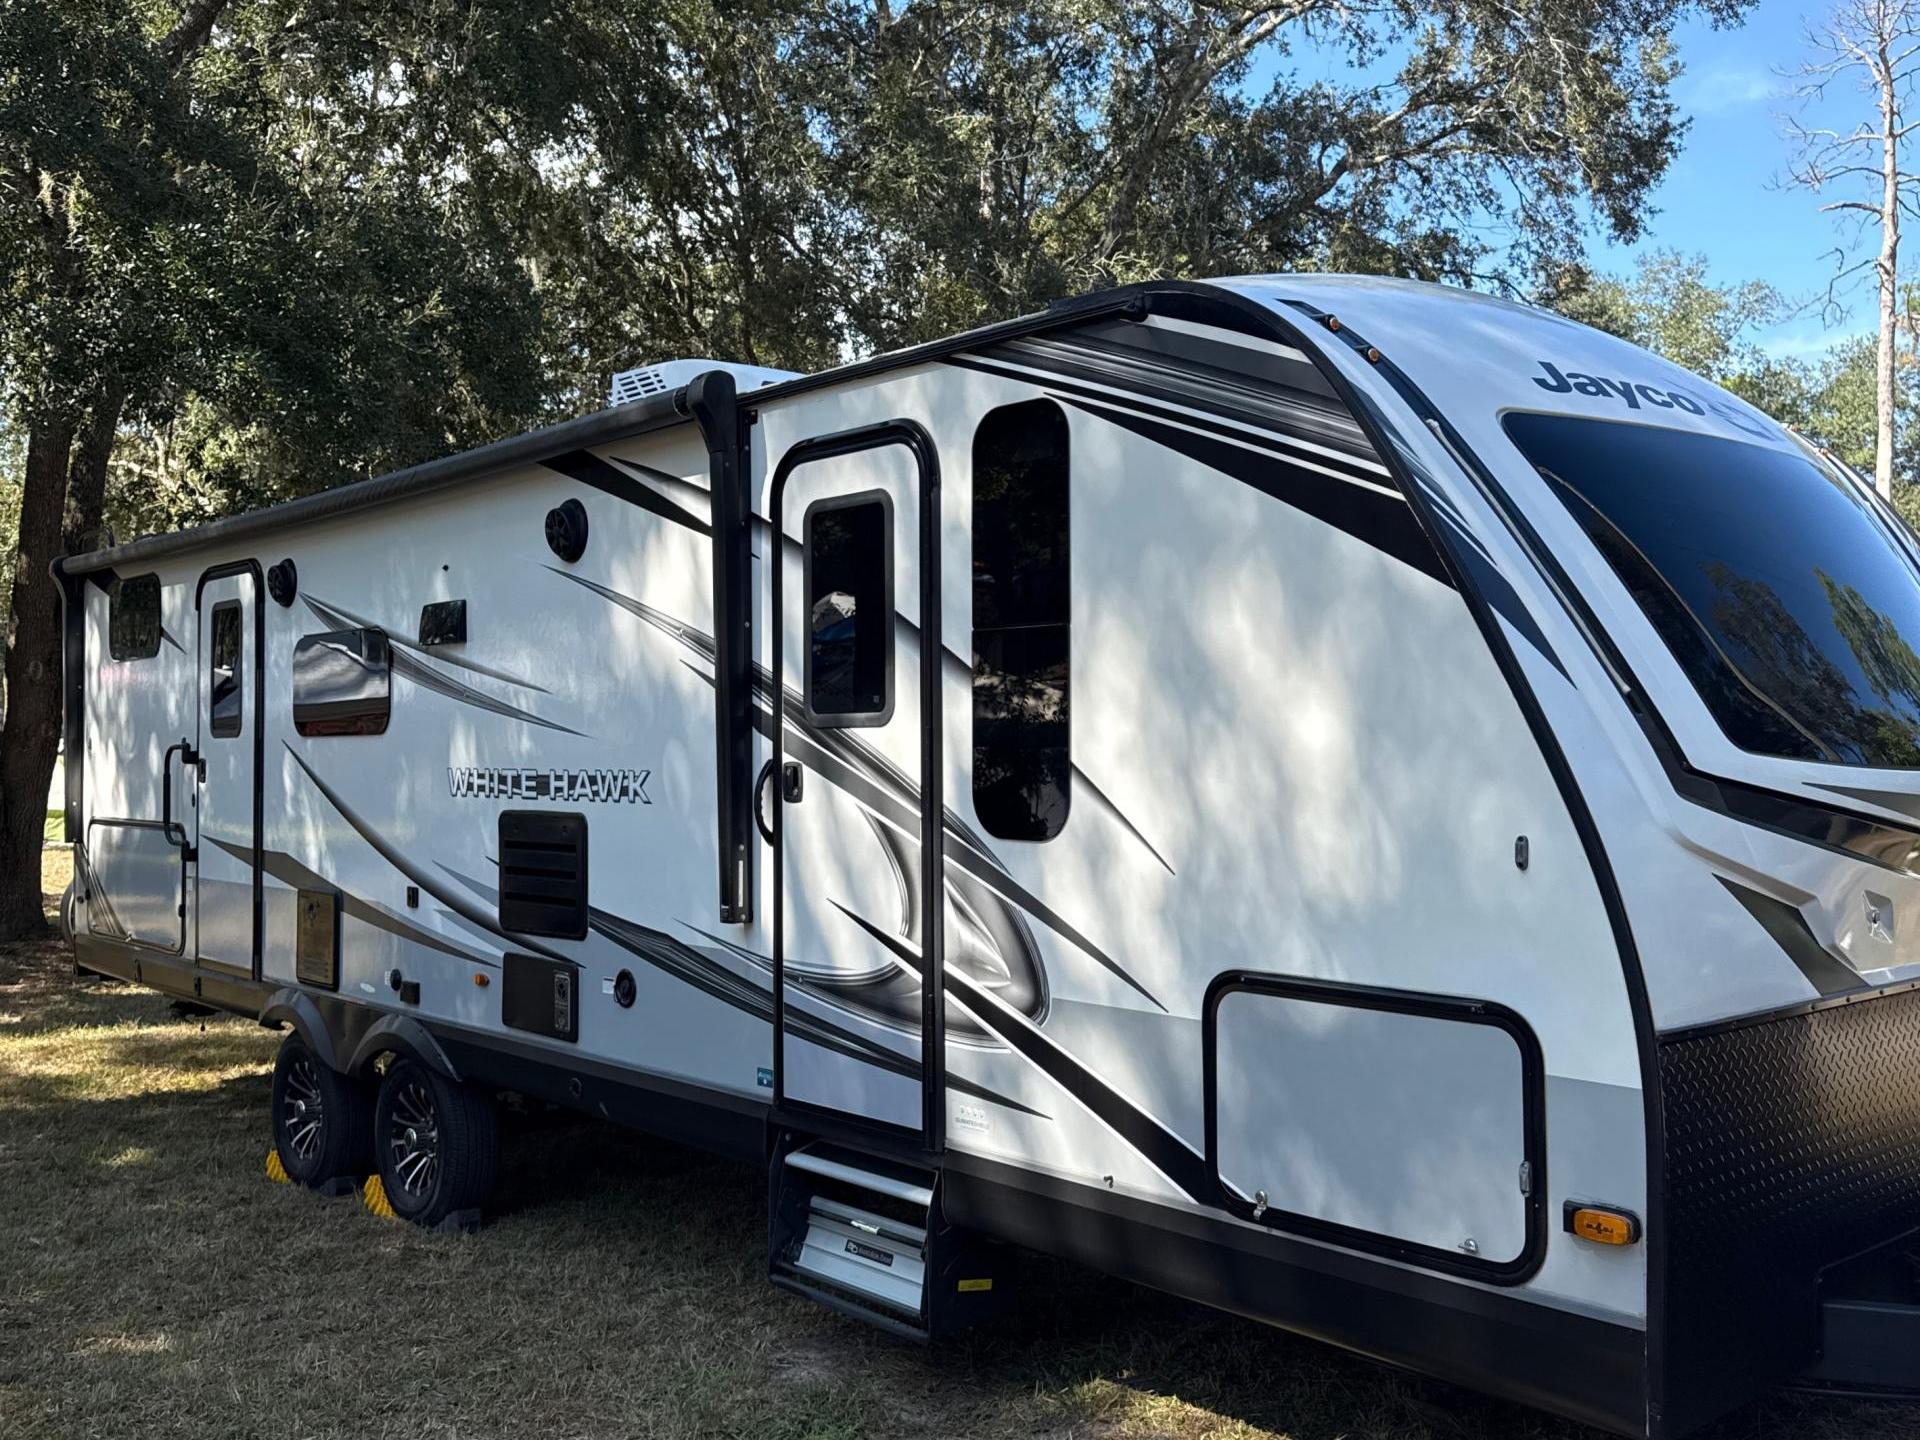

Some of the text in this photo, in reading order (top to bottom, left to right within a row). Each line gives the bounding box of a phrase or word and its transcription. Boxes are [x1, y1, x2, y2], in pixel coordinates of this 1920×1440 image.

[1531, 360, 1705, 416] Jayco
[447, 767, 653, 804] WHITE HAWK
